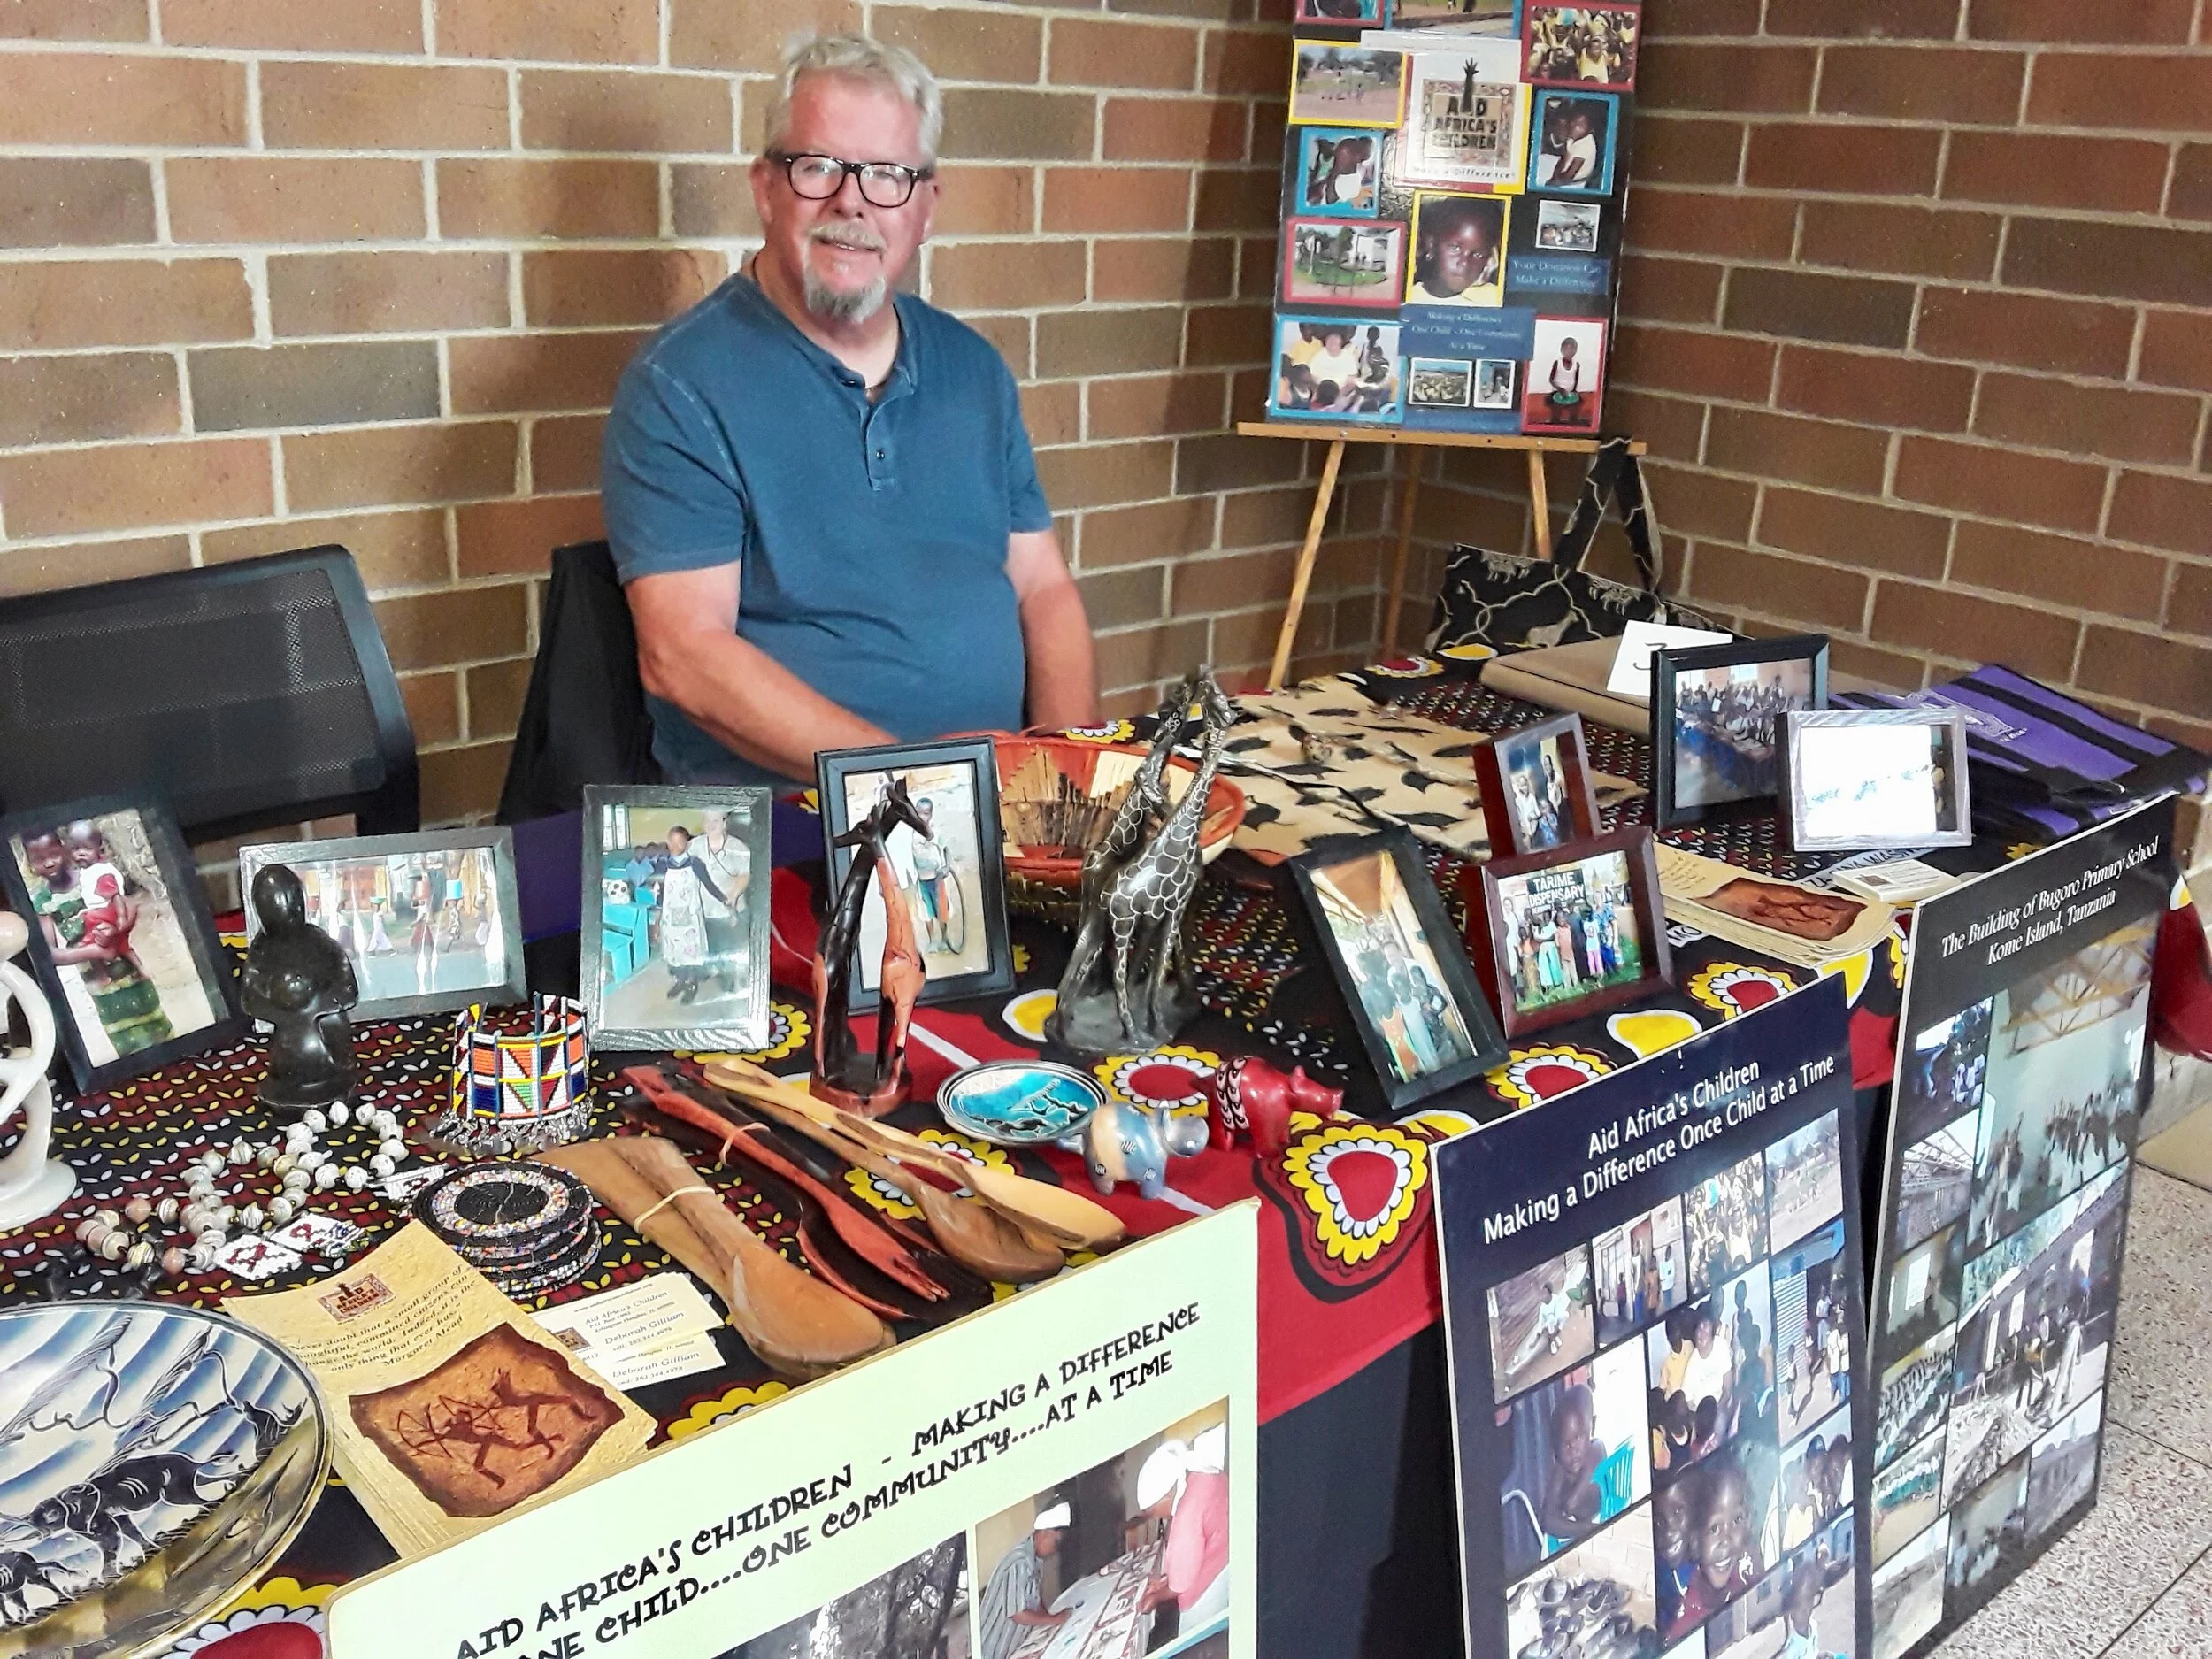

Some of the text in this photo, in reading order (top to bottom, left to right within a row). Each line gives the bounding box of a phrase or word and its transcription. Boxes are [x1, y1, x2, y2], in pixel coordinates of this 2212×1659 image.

[1432, 134, 1497, 150] LDREN
[1528, 883, 1585, 908] DISPENSARY
[1532, 871, 1576, 892] TARIME
[1940, 834, 2160, 958] The Building of Bugoro Primary School
[1985, 887, 2117, 967] Kome Island, Tanzania
[1587, 1058, 1761, 1161] Aid Africa's Children
[1483, 1055, 1835, 1246] Making a Difference Once Child at a Time
[296, 1344, 355, 1359] houghtful,
[357, 1317, 411, 1347] committed
[413, 1290, 449, 1318] citizens
[450, 1274, 468, 1290] can
[305, 1359, 337, 1368] hange
[342, 1352, 359, 1362] the
[460, 1279, 476, 1294] the
[326, 1333, 357, 1347] doubt
[360, 1322, 381, 1336] that
[395, 1298, 420, 1319] small
[422, 1275, 450, 1302] group
[452, 1264, 463, 1277] of
[604, 1311, 685, 1345] Deborah Gilliam
[633, 1291, 668, 1308] Children
[331, 1363, 355, 1372] only
[358, 1352, 387, 1366] thing
[389, 1340, 411, 1355] that
[413, 1326, 434, 1342] ever
[383, 1315, 463, 1367] Margaret Mead
[612, 1362, 658, 1378] Deborah
[661, 1351, 700, 1366] Gilliam
[457, 1617, 525, 1659] AID
[536, 1539, 683, 1632] AFRICA'S
[691, 1463, 854, 1556] CHILDREN
[910, 1383, 1026, 1457] MAKING
[1034, 1373, 1051, 1399] A
[1058, 1302, 1201, 1386] DIFFERENCE
[518, 1631, 585, 1659] NE
[1086, 1385, 1102, 1410] A
[1109, 1349, 1174, 1400] TIME
